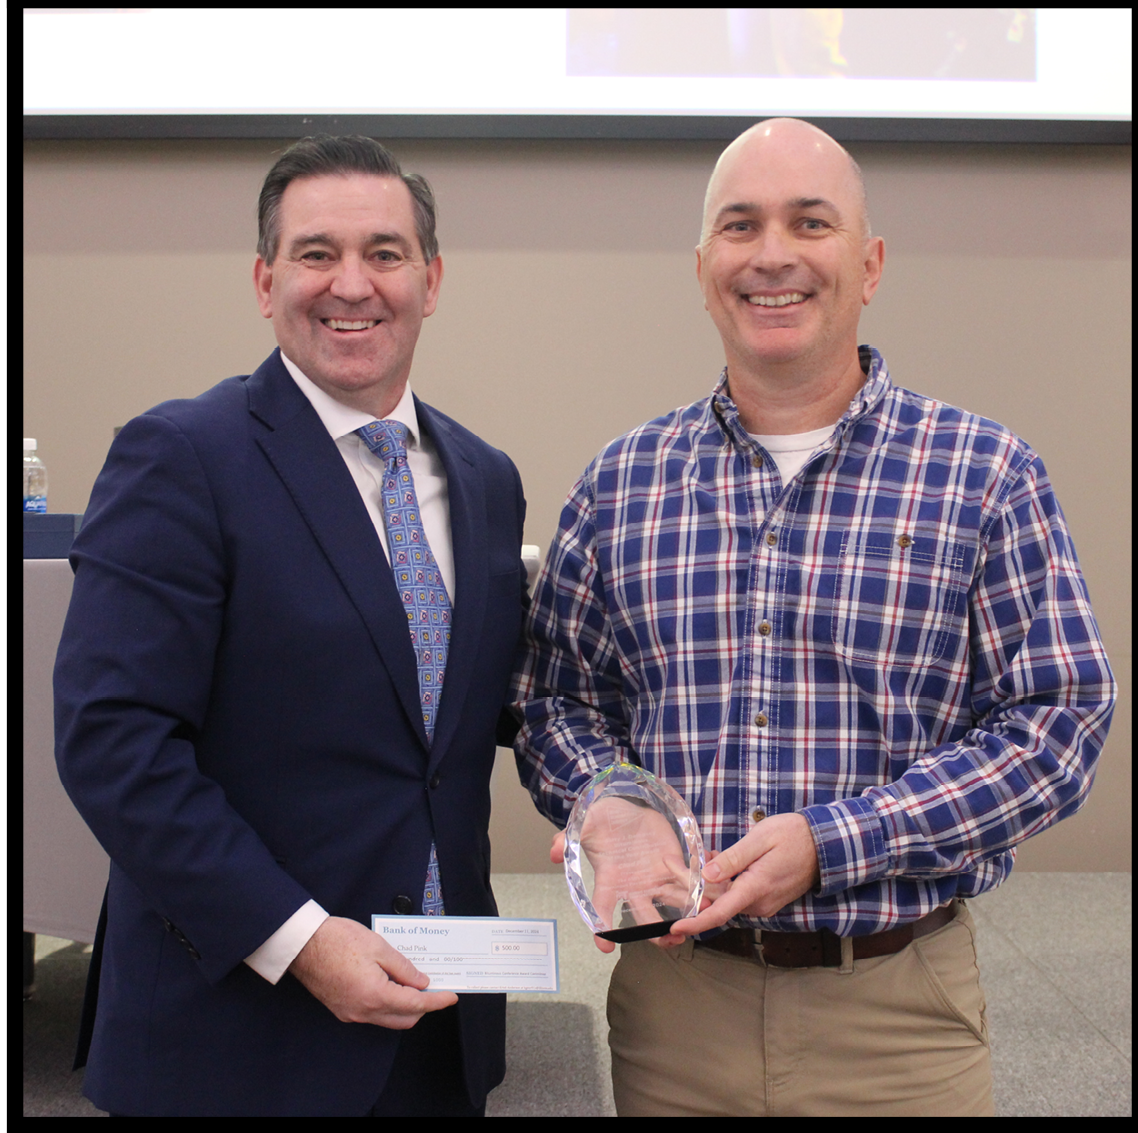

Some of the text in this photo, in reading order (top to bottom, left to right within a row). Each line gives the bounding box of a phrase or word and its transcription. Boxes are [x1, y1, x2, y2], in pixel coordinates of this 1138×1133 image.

[383, 926, 450, 936] Bank of Money
